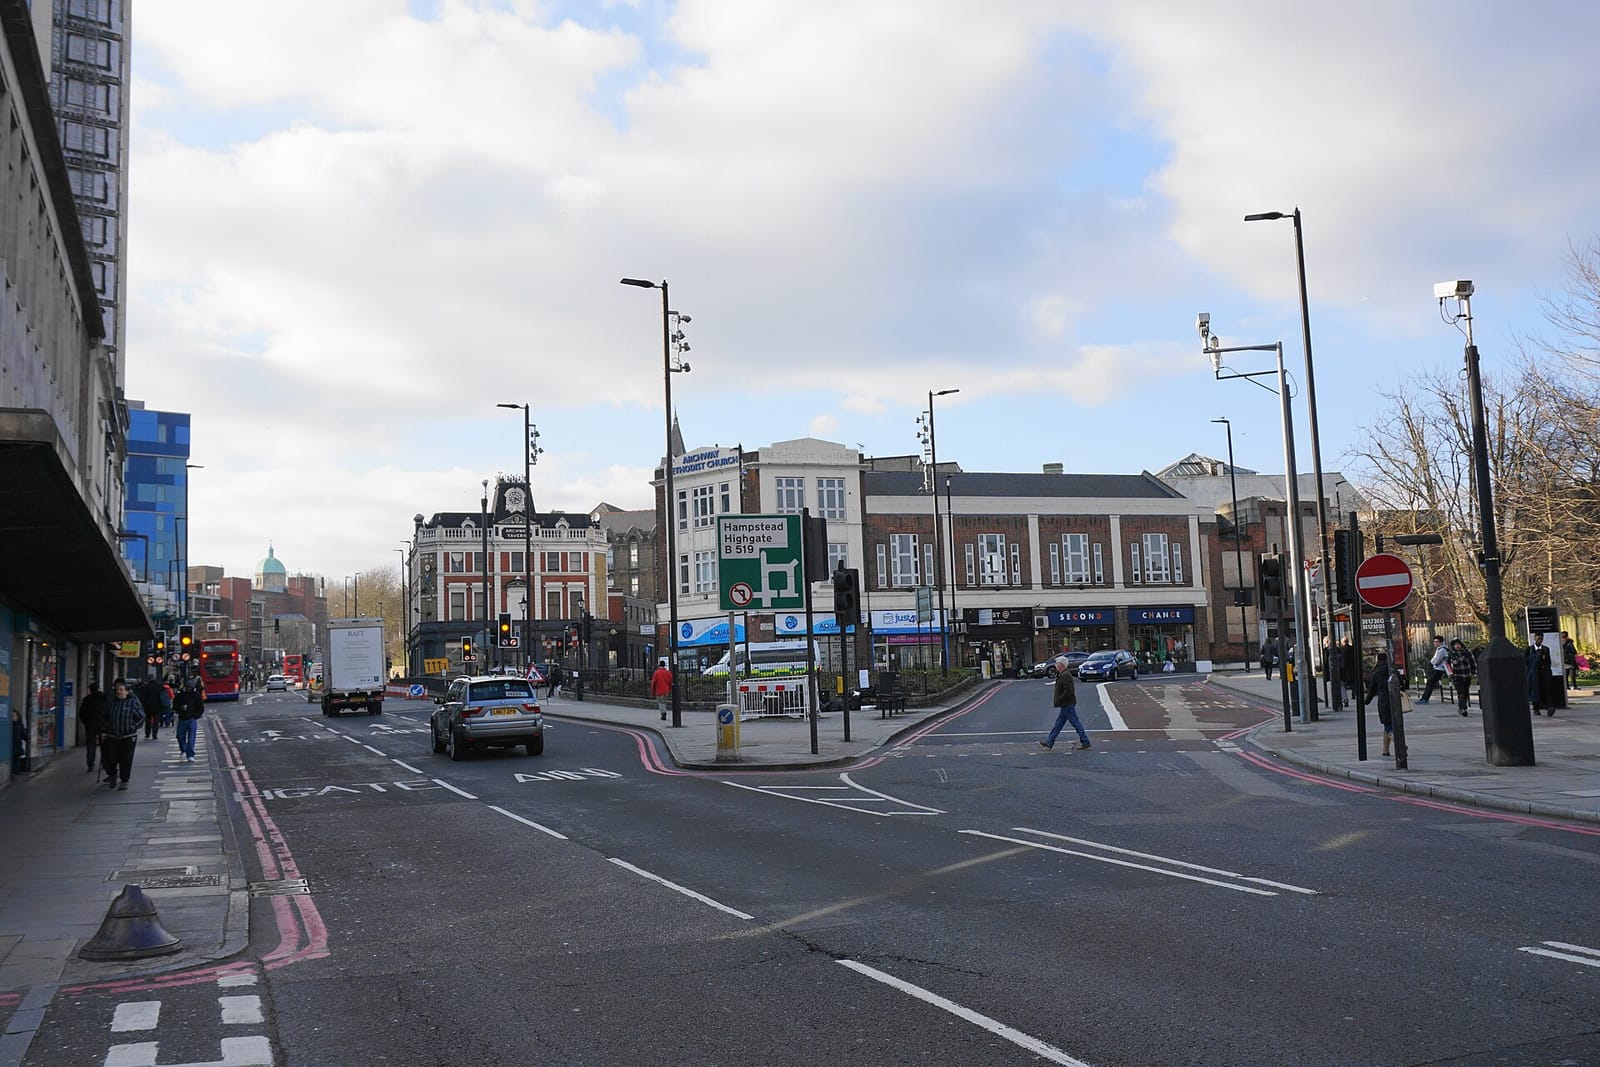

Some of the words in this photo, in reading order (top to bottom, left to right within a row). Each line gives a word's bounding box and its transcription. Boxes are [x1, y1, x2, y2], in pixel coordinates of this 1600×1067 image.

[683, 450, 720, 464] ARCHWAY
[672, 462, 705, 476] ETHODIST
[706, 455, 739, 470] CHURCH
[724, 521, 784, 533] Hampstead
[724, 533, 773, 545] Highgate
[725, 545, 732, 554] B
[735, 544, 754, 554] 519
[1059, 613, 1102, 621] SECOND
[1142, 611, 1181, 619] CHANCE
